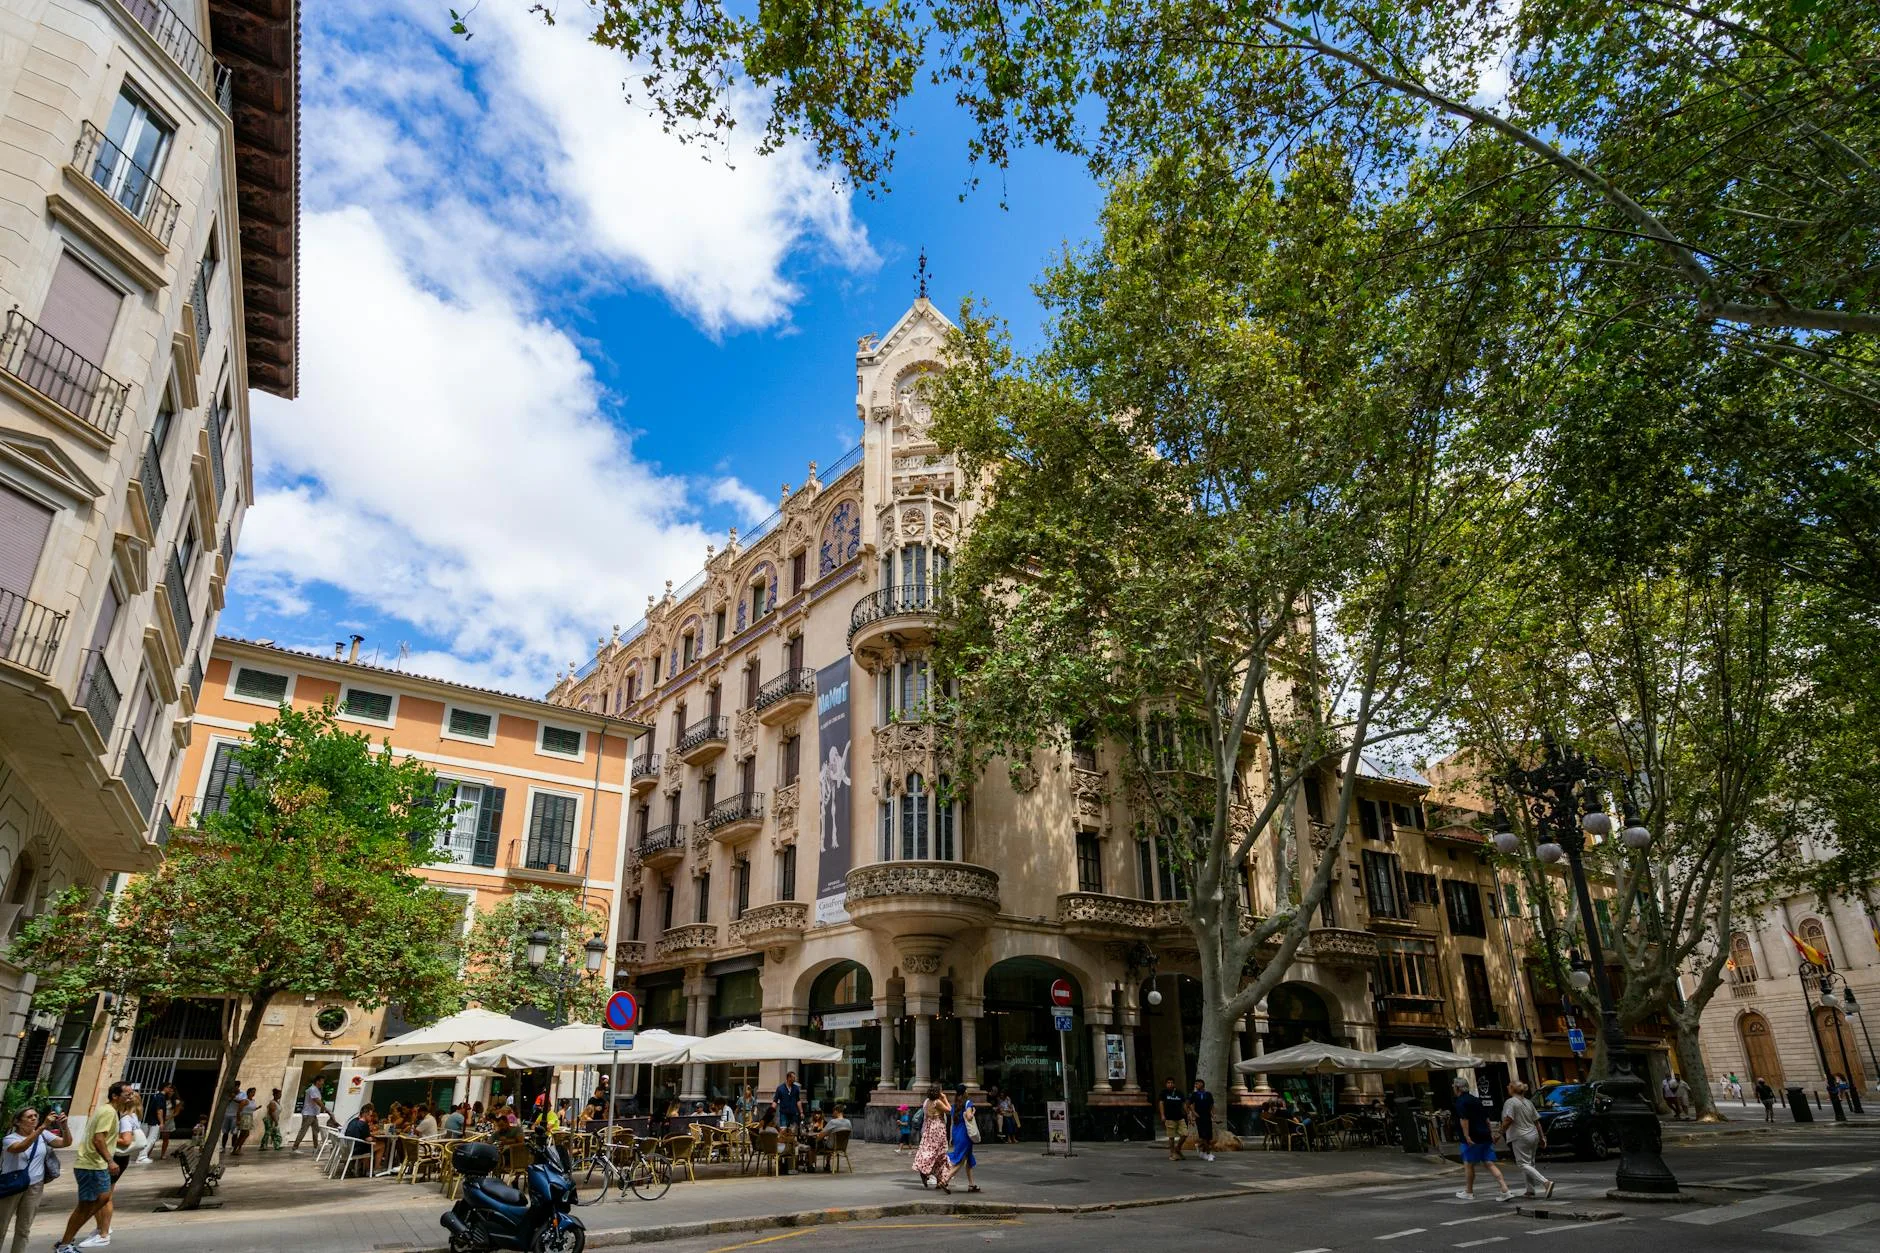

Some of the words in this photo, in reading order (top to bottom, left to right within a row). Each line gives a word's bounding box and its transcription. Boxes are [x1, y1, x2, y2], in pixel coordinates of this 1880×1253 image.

[819, 898, 844, 910] CaixaForu
[1569, 1036, 1585, 1045] TAXI
[1004, 1055, 1049, 1065] CaixaForum
